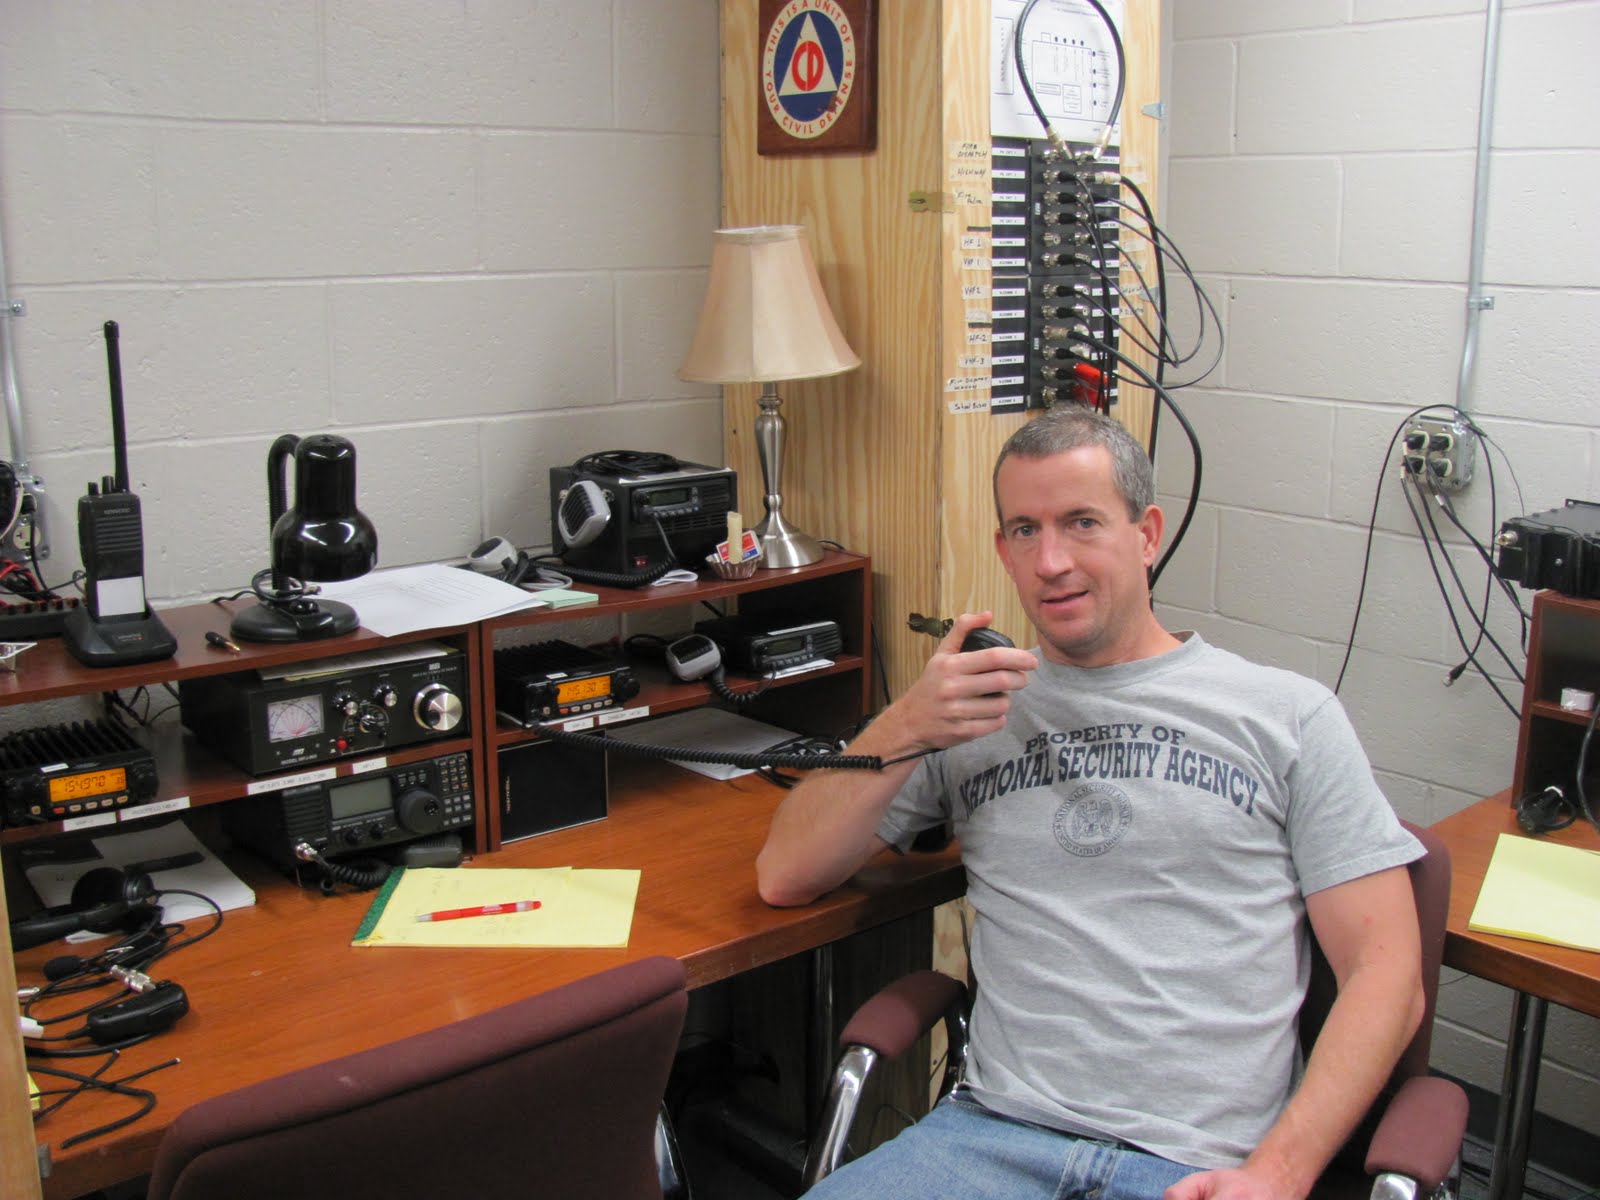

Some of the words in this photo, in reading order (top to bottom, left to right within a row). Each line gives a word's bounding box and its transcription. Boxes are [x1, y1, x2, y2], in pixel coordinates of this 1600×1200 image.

[767, 19, 785, 54] THIS
[787, 3, 798, 18] IS
[802, 0, 809, 8] A
[815, 0, 842, 21] UNIT
[840, 24, 851, 44] OF
[766, 71, 780, 114] YOUR
[782, 116, 814, 134] CIVIL
[1024, 724, 1143, 754] PROPERTY
[1152, 725, 1186, 745] OF
[959, 749, 1053, 820] NATIONAL
[1058, 741, 1161, 782] SECURITY
[1164, 745, 1258, 816] AGENCY
[1056, 789, 1083, 824] NATIONAL
[1082, 784, 1115, 797] SECURITY
[1113, 794, 1130, 819] AGENCY
[1056, 829, 1073, 849] UNITED
[1071, 846, 1093, 855] STATES
